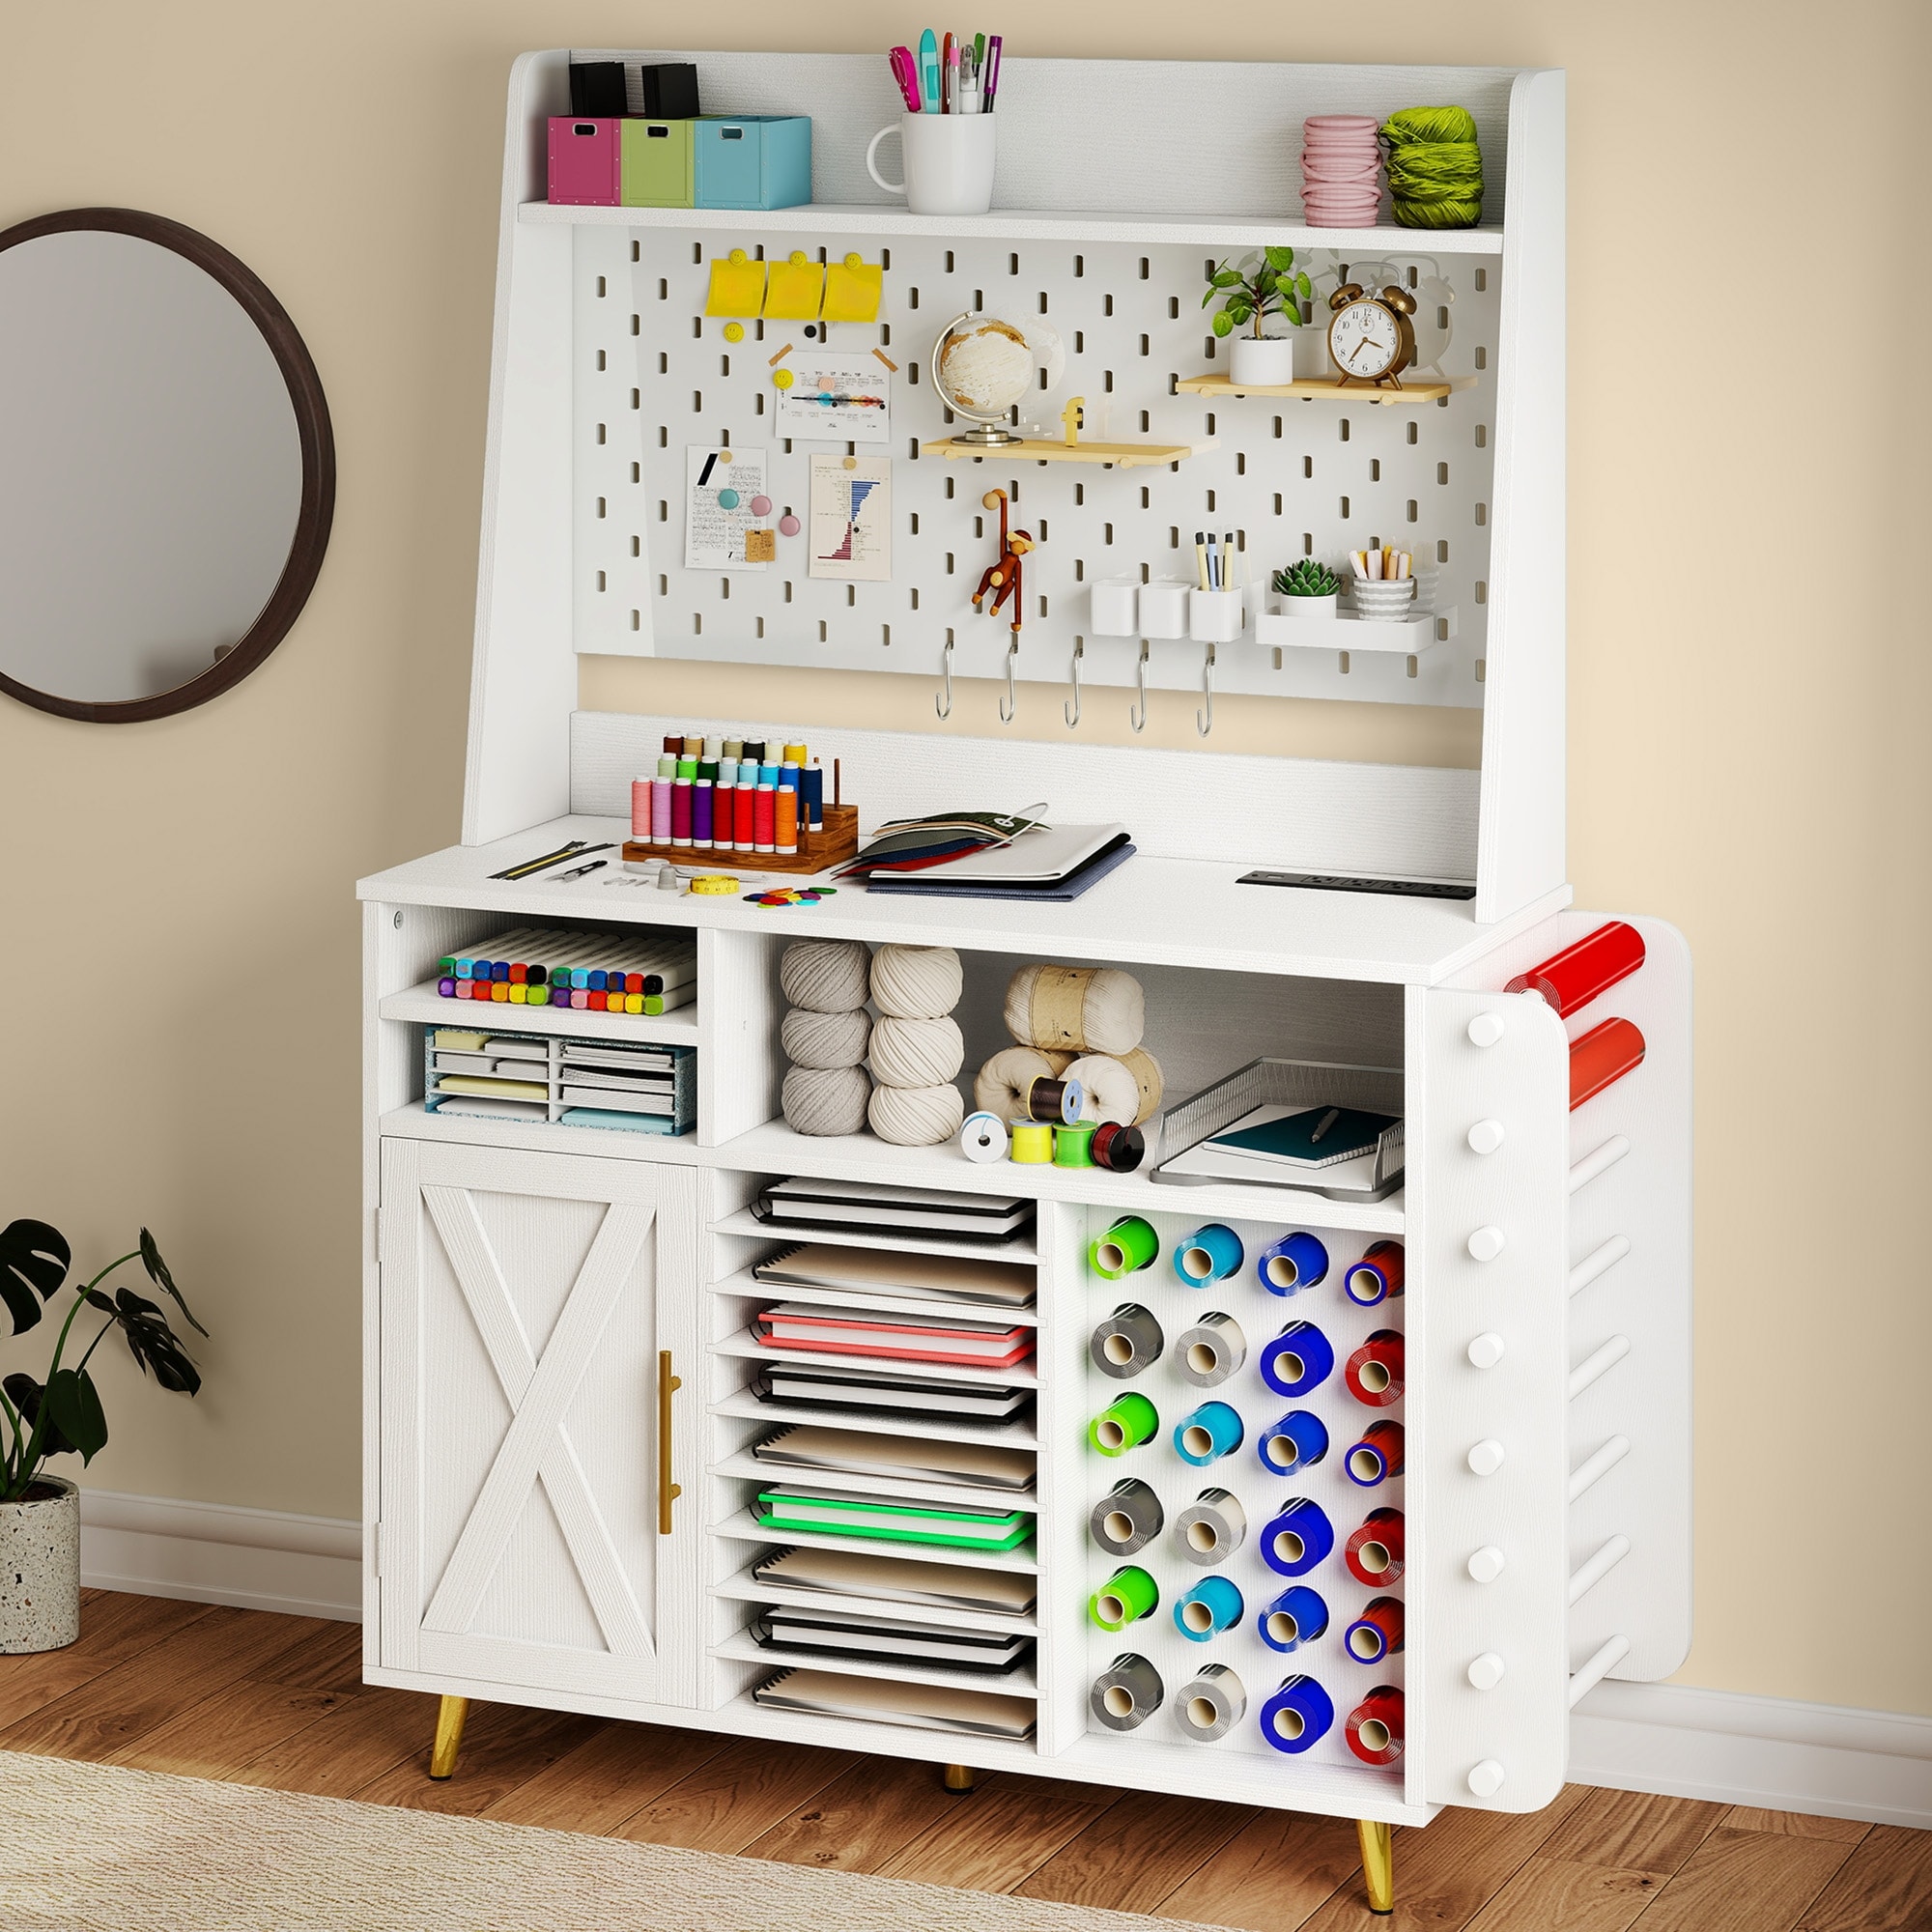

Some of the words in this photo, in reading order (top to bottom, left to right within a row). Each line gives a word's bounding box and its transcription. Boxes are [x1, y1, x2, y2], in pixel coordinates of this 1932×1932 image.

[1364, 308, 1372, 317] 12
[1386, 323, 1393, 331] 2
[1390, 337, 1396, 346] 3
[1377, 360, 1382, 369] 5
